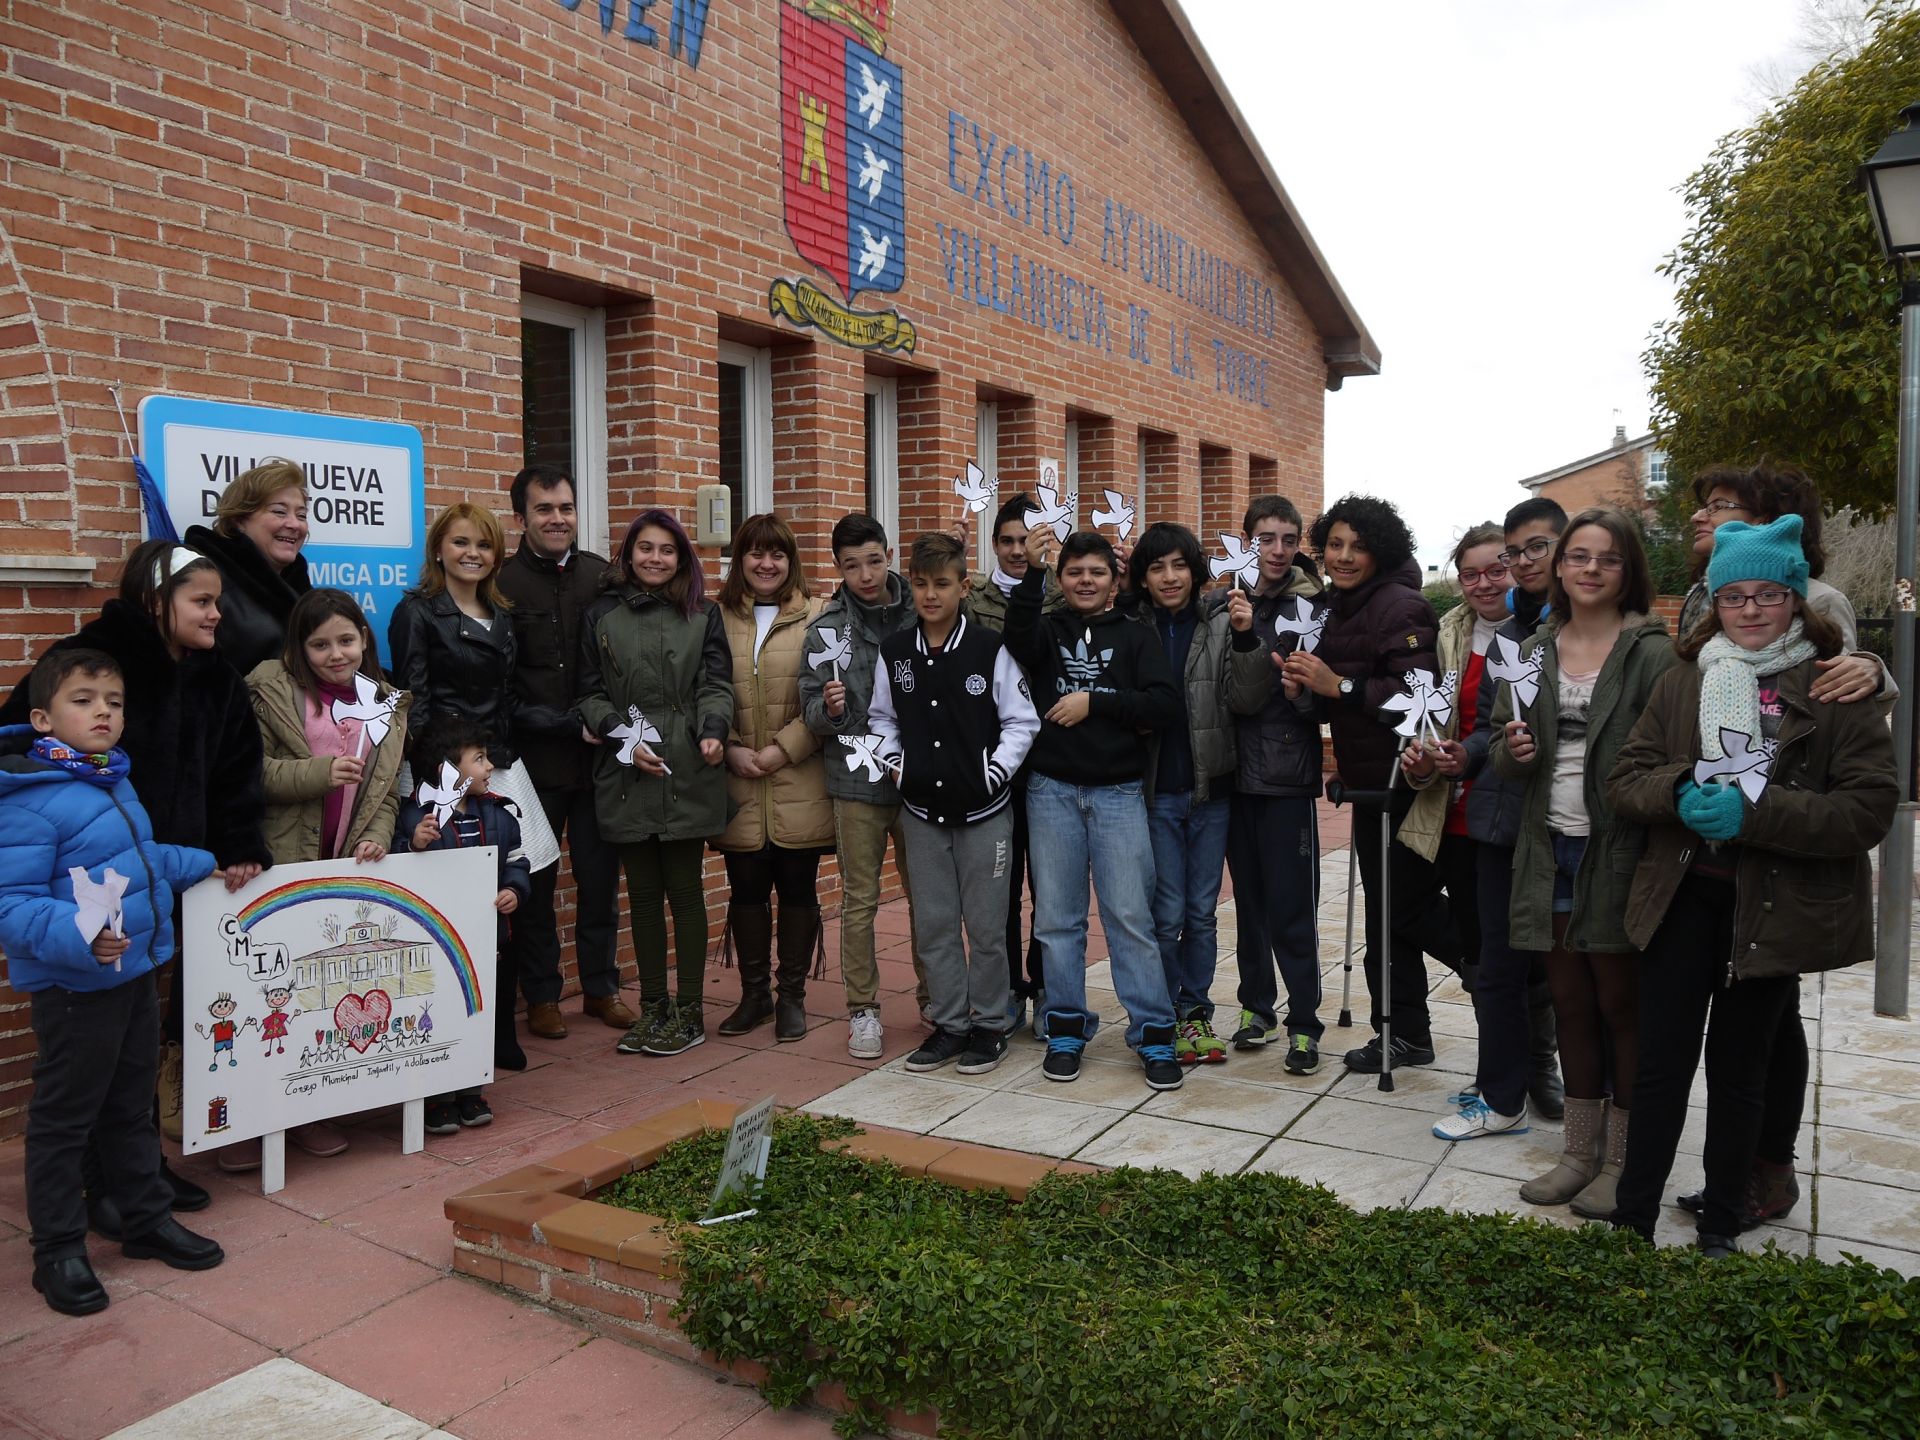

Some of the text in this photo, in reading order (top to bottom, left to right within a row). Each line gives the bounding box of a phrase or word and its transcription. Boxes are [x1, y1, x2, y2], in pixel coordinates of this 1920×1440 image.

[1101, 197, 1274, 339] AYUNTAMIENTO
[935, 222, 1271, 408] VILLANUEVA DE LA TORRE
[308, 496, 384, 526] ORRE
[379, 564, 408, 586] DE
[315, 1007, 434, 1046] VILLANUEVA
[322, 1070, 359, 1088] Municipal
[367, 1063, 394, 1078] Infantil
